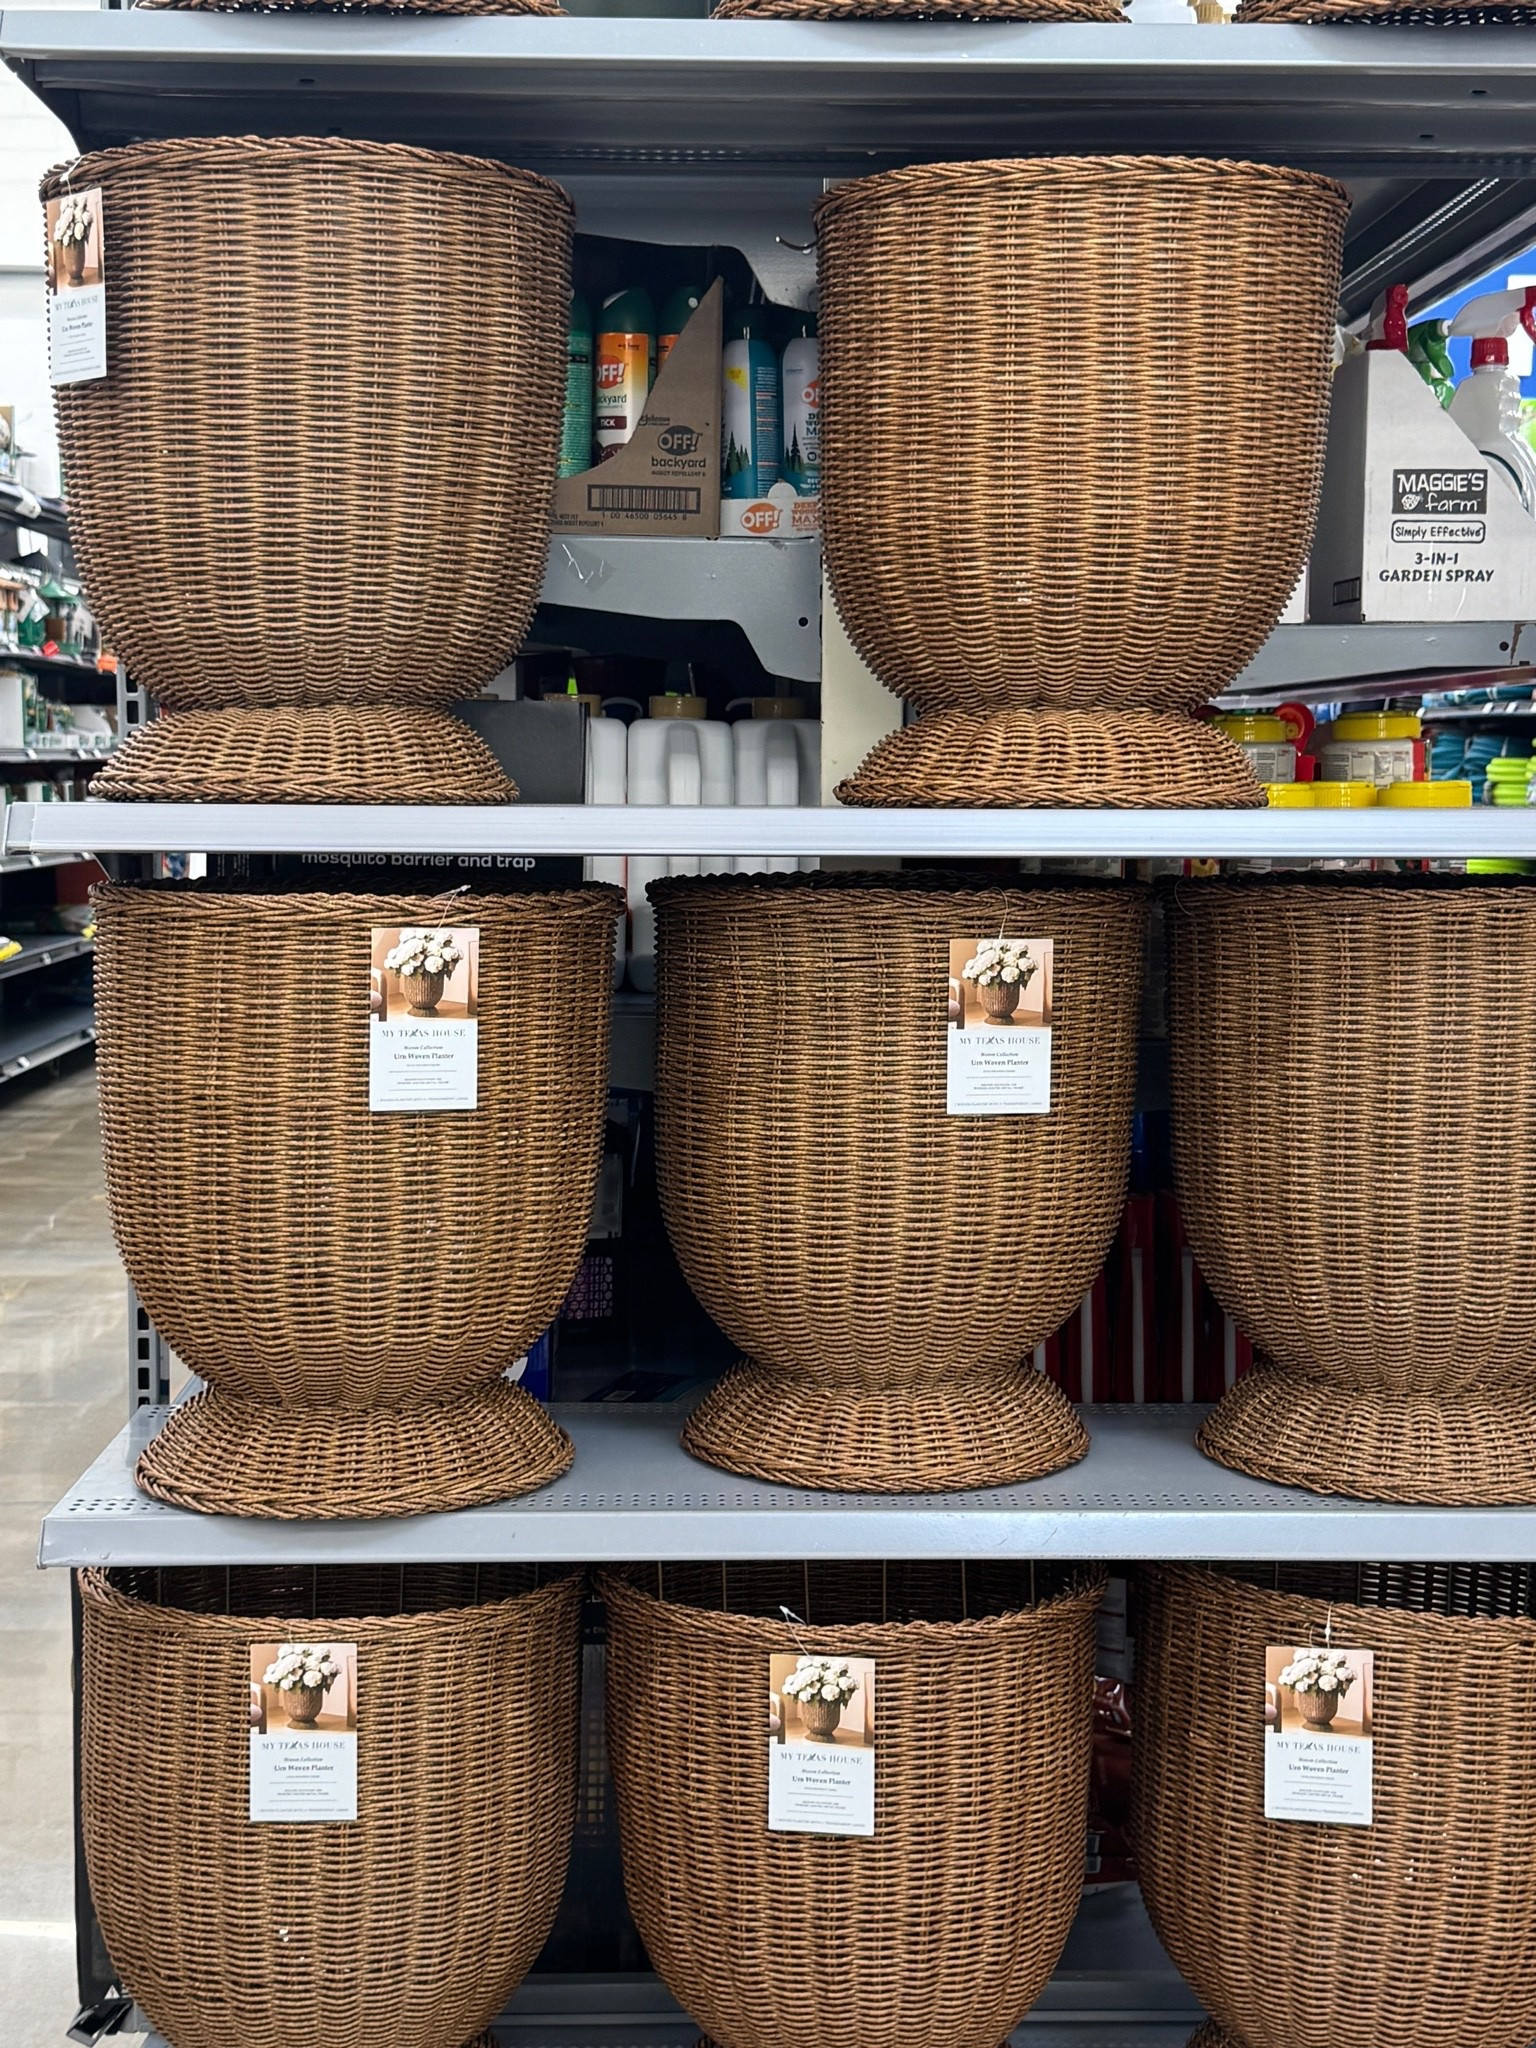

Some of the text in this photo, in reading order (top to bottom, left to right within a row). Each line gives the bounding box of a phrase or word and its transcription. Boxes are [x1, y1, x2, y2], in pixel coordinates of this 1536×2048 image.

[659, 432, 698, 452] OFF!
[651, 456, 706, 470] backyard
[1397, 472, 1485, 493] MAGGIE'S
[1425, 492, 1478, 512] farm
[741, 510, 780, 528] OFF!
[1395, 526, 1482, 540] Simply Effective
[1415, 552, 1459, 565] 3-IN-1
[1379, 569, 1495, 582] GARDEN SPRAY
[301, 853, 536, 872] mosquito barrier and trap
[382, 1029, 466, 1038] MY TEXAS HOUSE
[960, 1036, 1041, 1045] MY TEXAS HOUSE
[262, 1740, 346, 1750] MY TEXAS HOUSE
[1277, 1741, 1361, 1754] MY TEXAS HOUSE
[781, 1752, 863, 1765] MY TEXAS HOUSE
[1303, 1764, 1324, 1773] Woven
[1326, 1766, 1349, 1774] Planter
[806, 1776, 828, 1784] Woven
[829, 1777, 851, 1785] Planter
